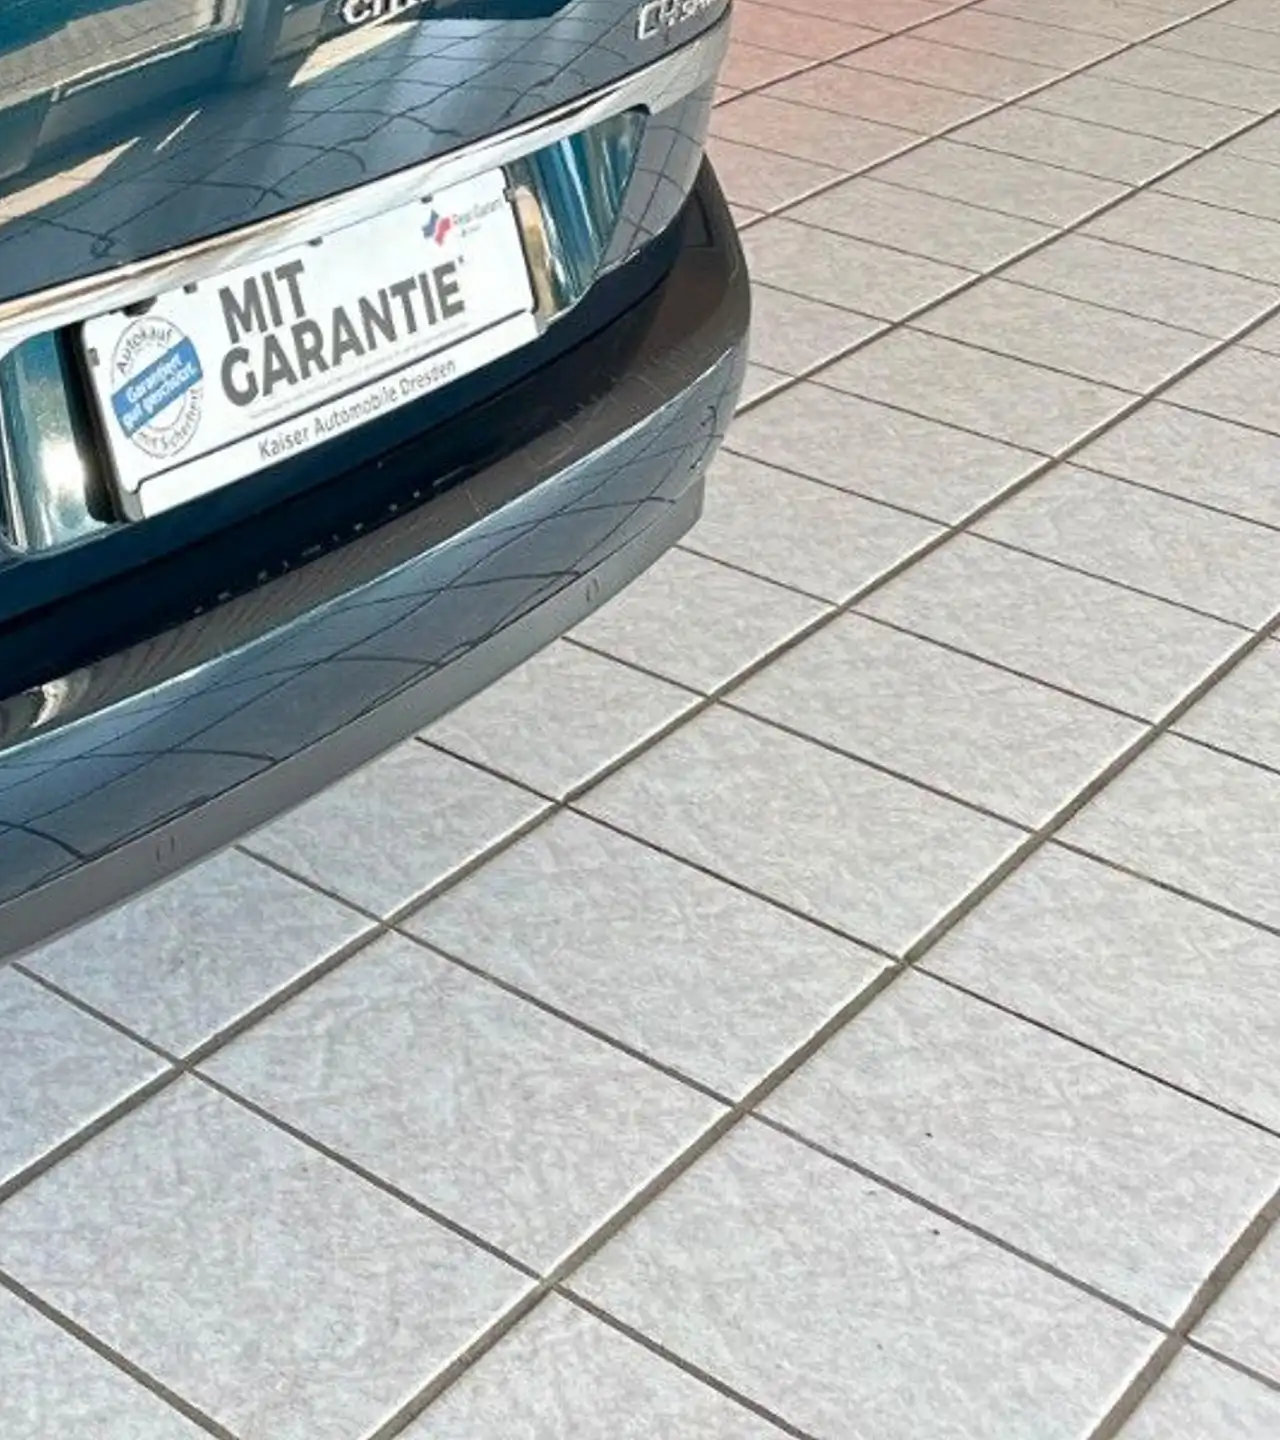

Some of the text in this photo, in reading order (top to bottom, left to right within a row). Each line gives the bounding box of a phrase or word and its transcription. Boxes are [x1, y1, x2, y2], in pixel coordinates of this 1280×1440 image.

[218, 259, 307, 344] MIT
[220, 260, 466, 408] GARANTIE
[257, 358, 457, 460] Kaiser Automobile Dresden
